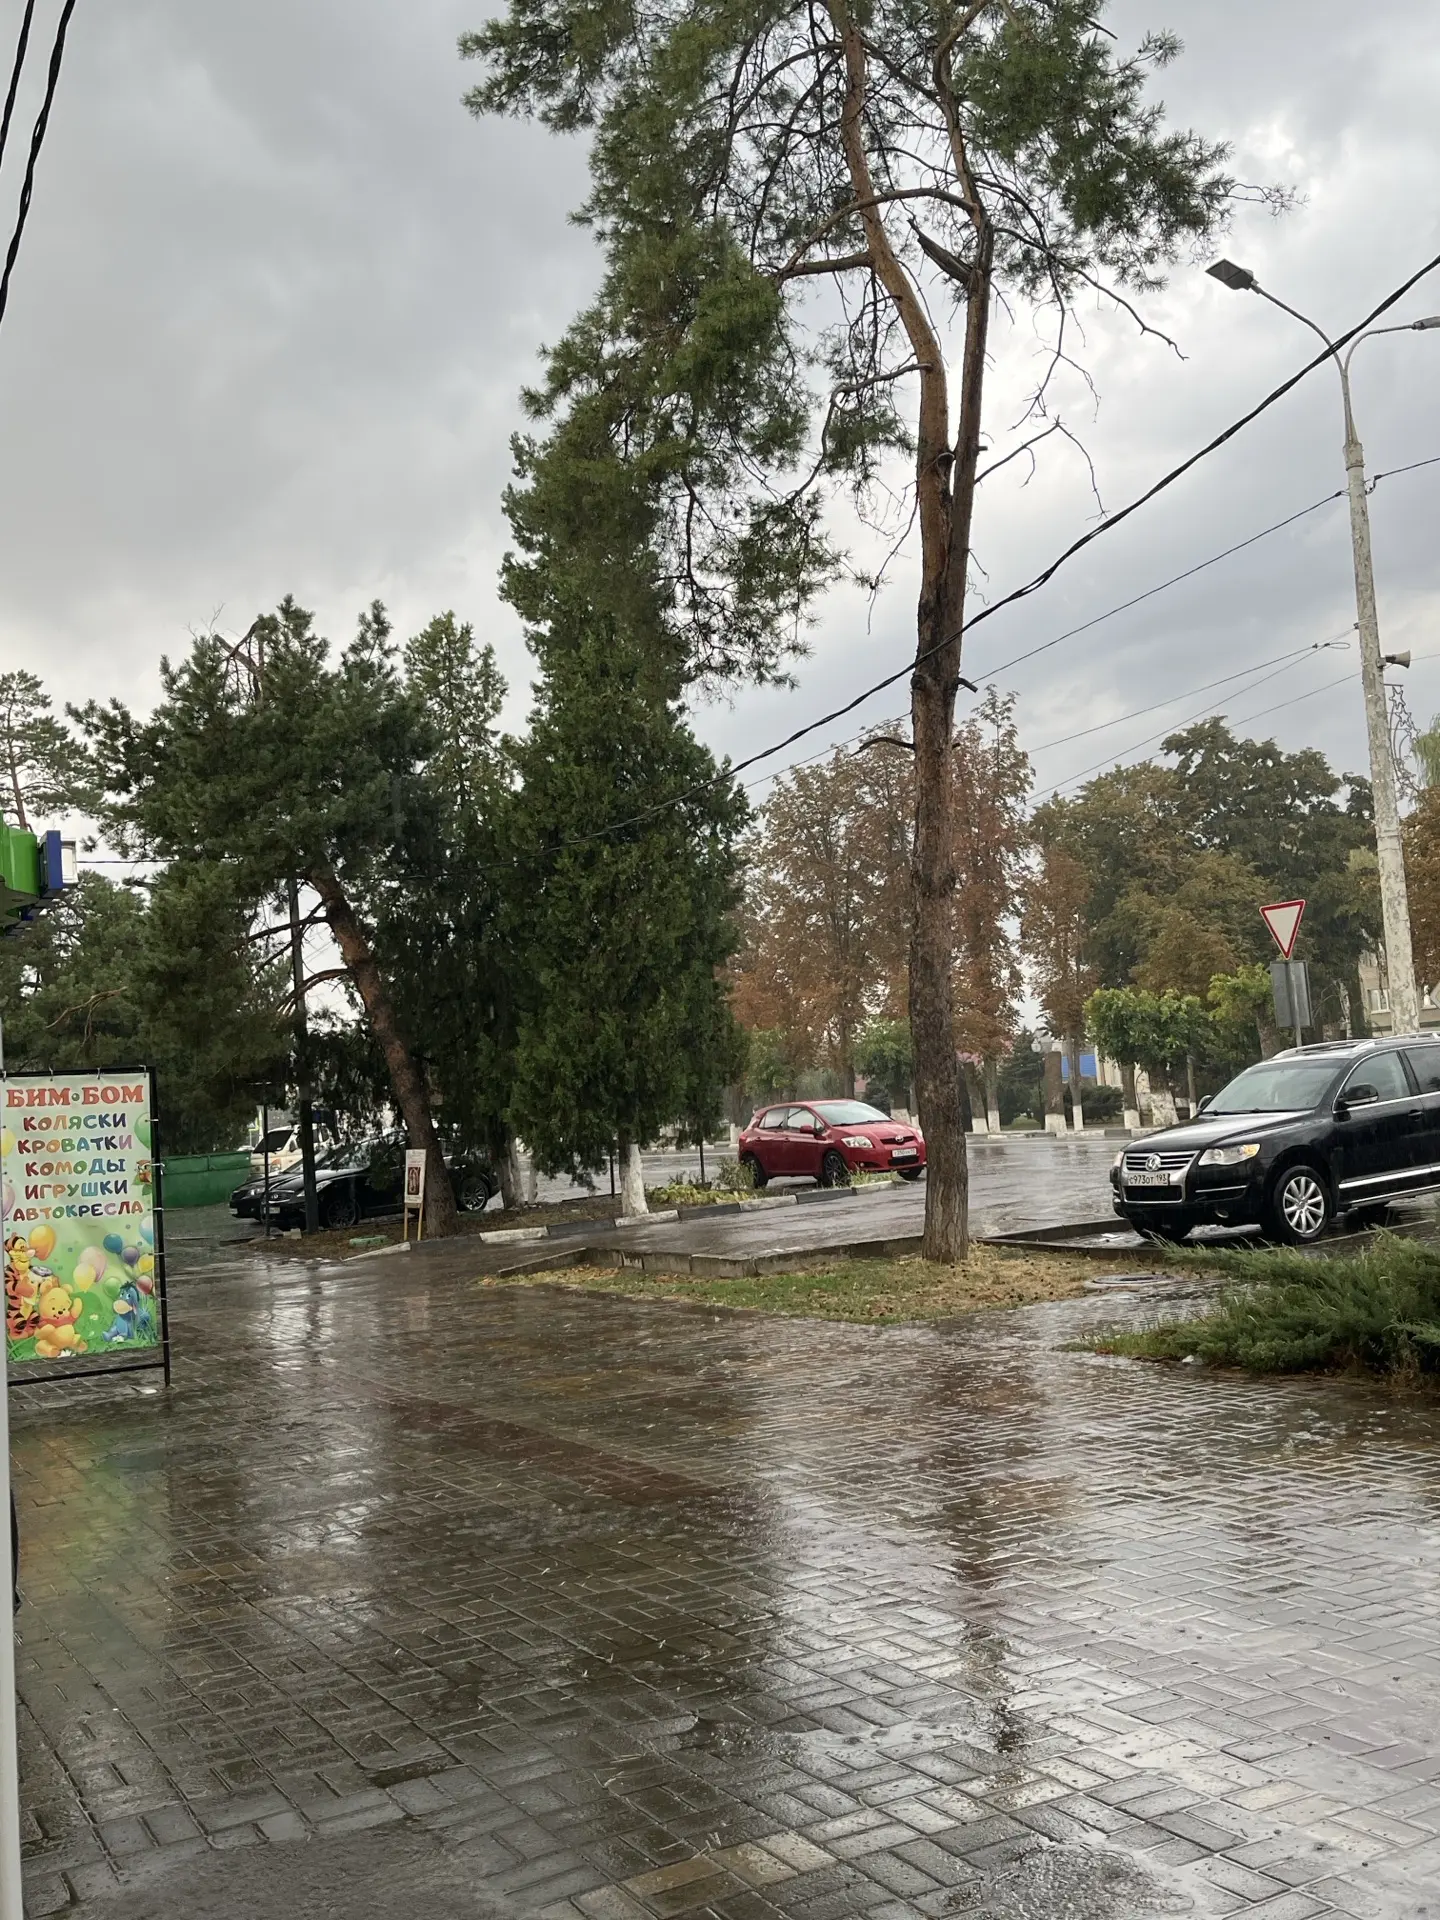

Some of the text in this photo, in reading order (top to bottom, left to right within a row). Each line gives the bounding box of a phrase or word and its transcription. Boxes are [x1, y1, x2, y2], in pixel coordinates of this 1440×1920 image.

[23, 1113, 126, 1131] КОЛЯСКИ
[17, 1135, 132, 1154] КРОВАТКИ
[25, 1158, 126, 1177] КОМОДЫ
[25, 1180, 128, 1200] ИГРУШКИ
[13, 1201, 143, 1221] АВТОКРЕСЛА
